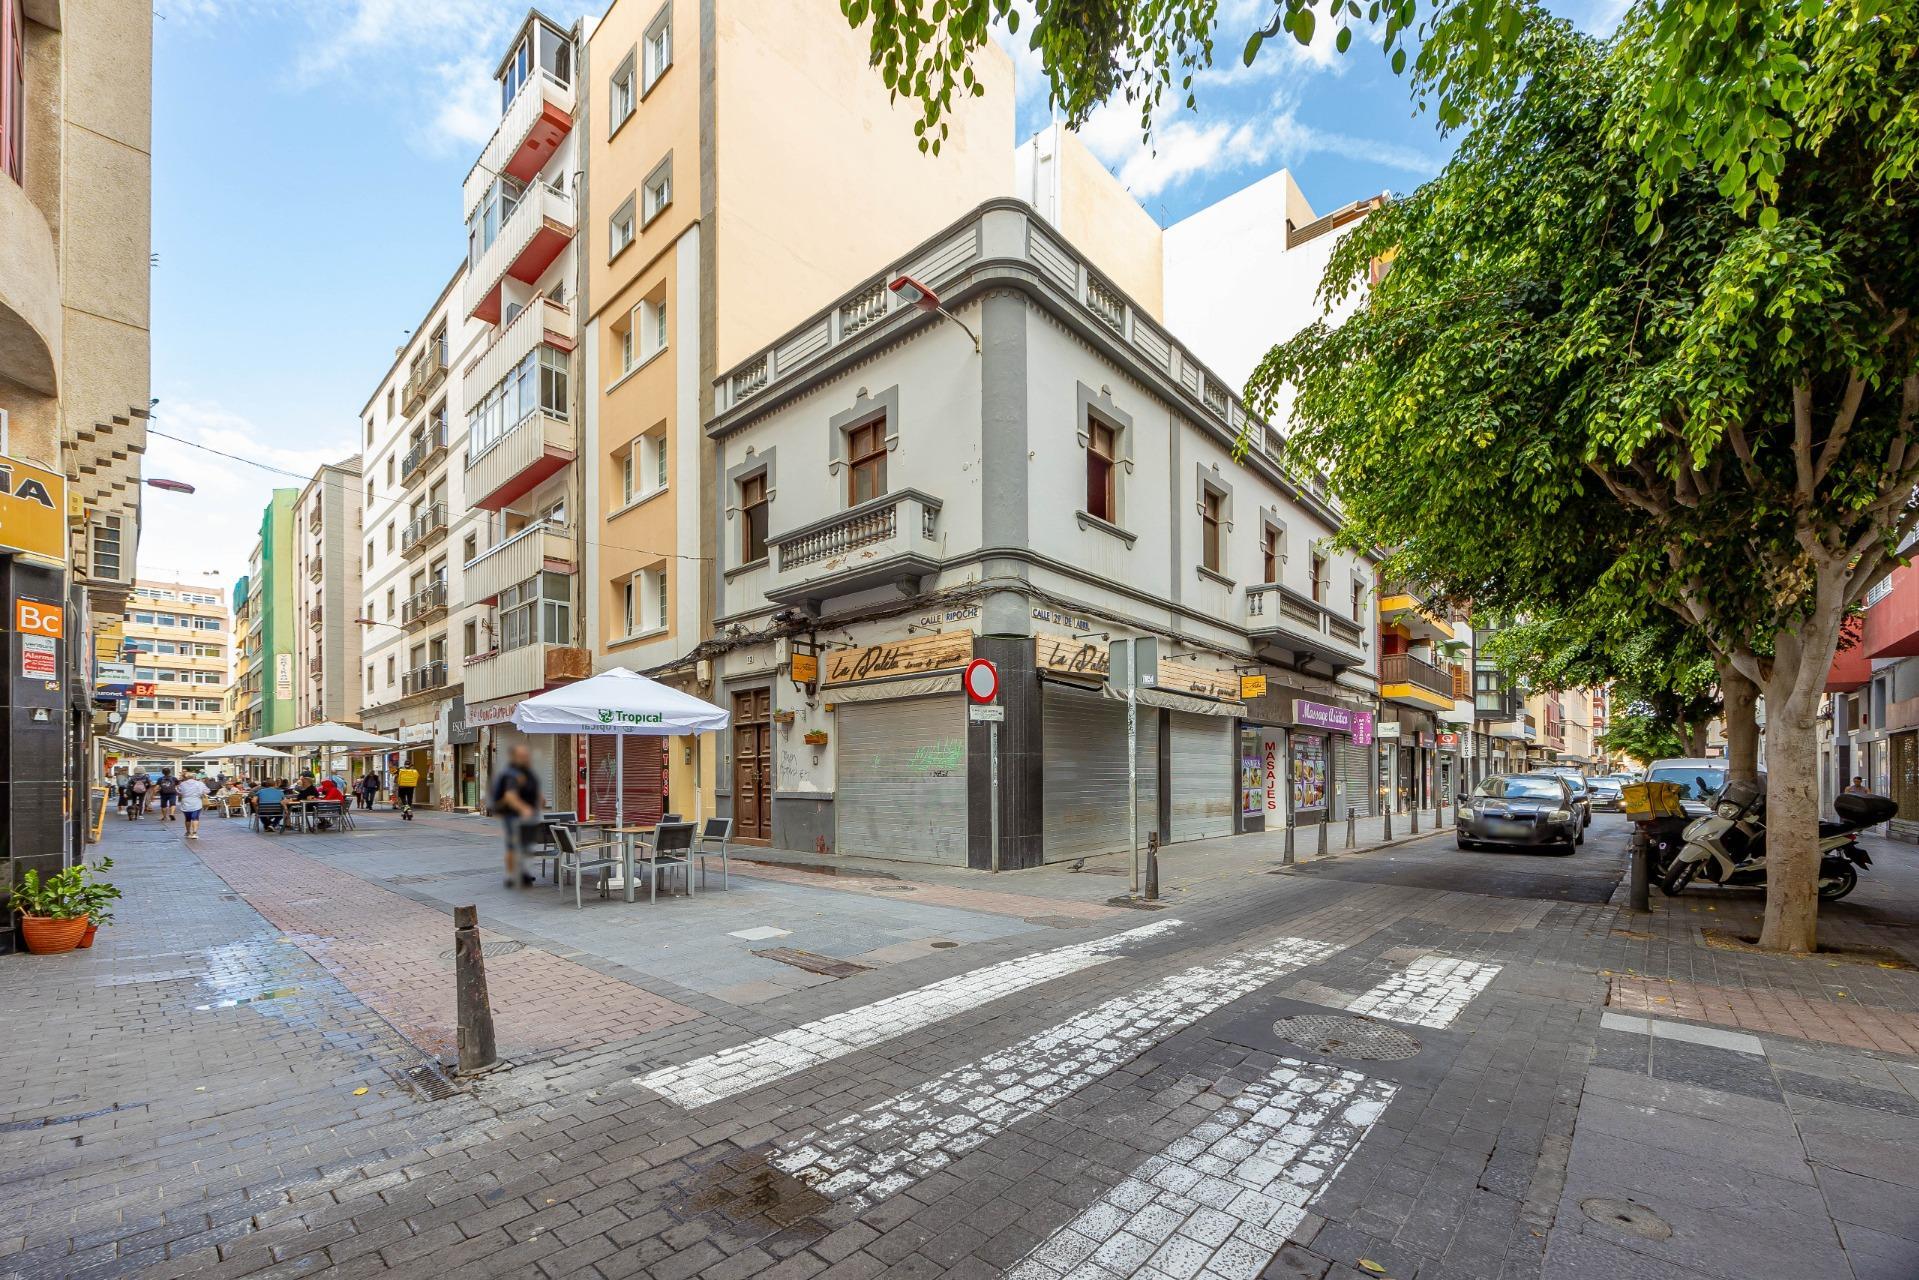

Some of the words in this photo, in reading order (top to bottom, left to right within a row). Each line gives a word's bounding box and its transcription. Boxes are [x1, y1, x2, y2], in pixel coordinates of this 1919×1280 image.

[20, 605, 59, 632] Bc
[921, 613, 942, 626] CALLE
[946, 608, 979, 621] RIPOCHE
[1032, 608, 1051, 620] CALLE
[1064, 616, 1073, 625] DE
[1048, 641, 1067, 667] La
[831, 657, 850, 680] La
[616, 711, 663, 724] Tropical
[1303, 703, 1328, 726] Massage
[1264, 742, 1277, 810] MASAJES
